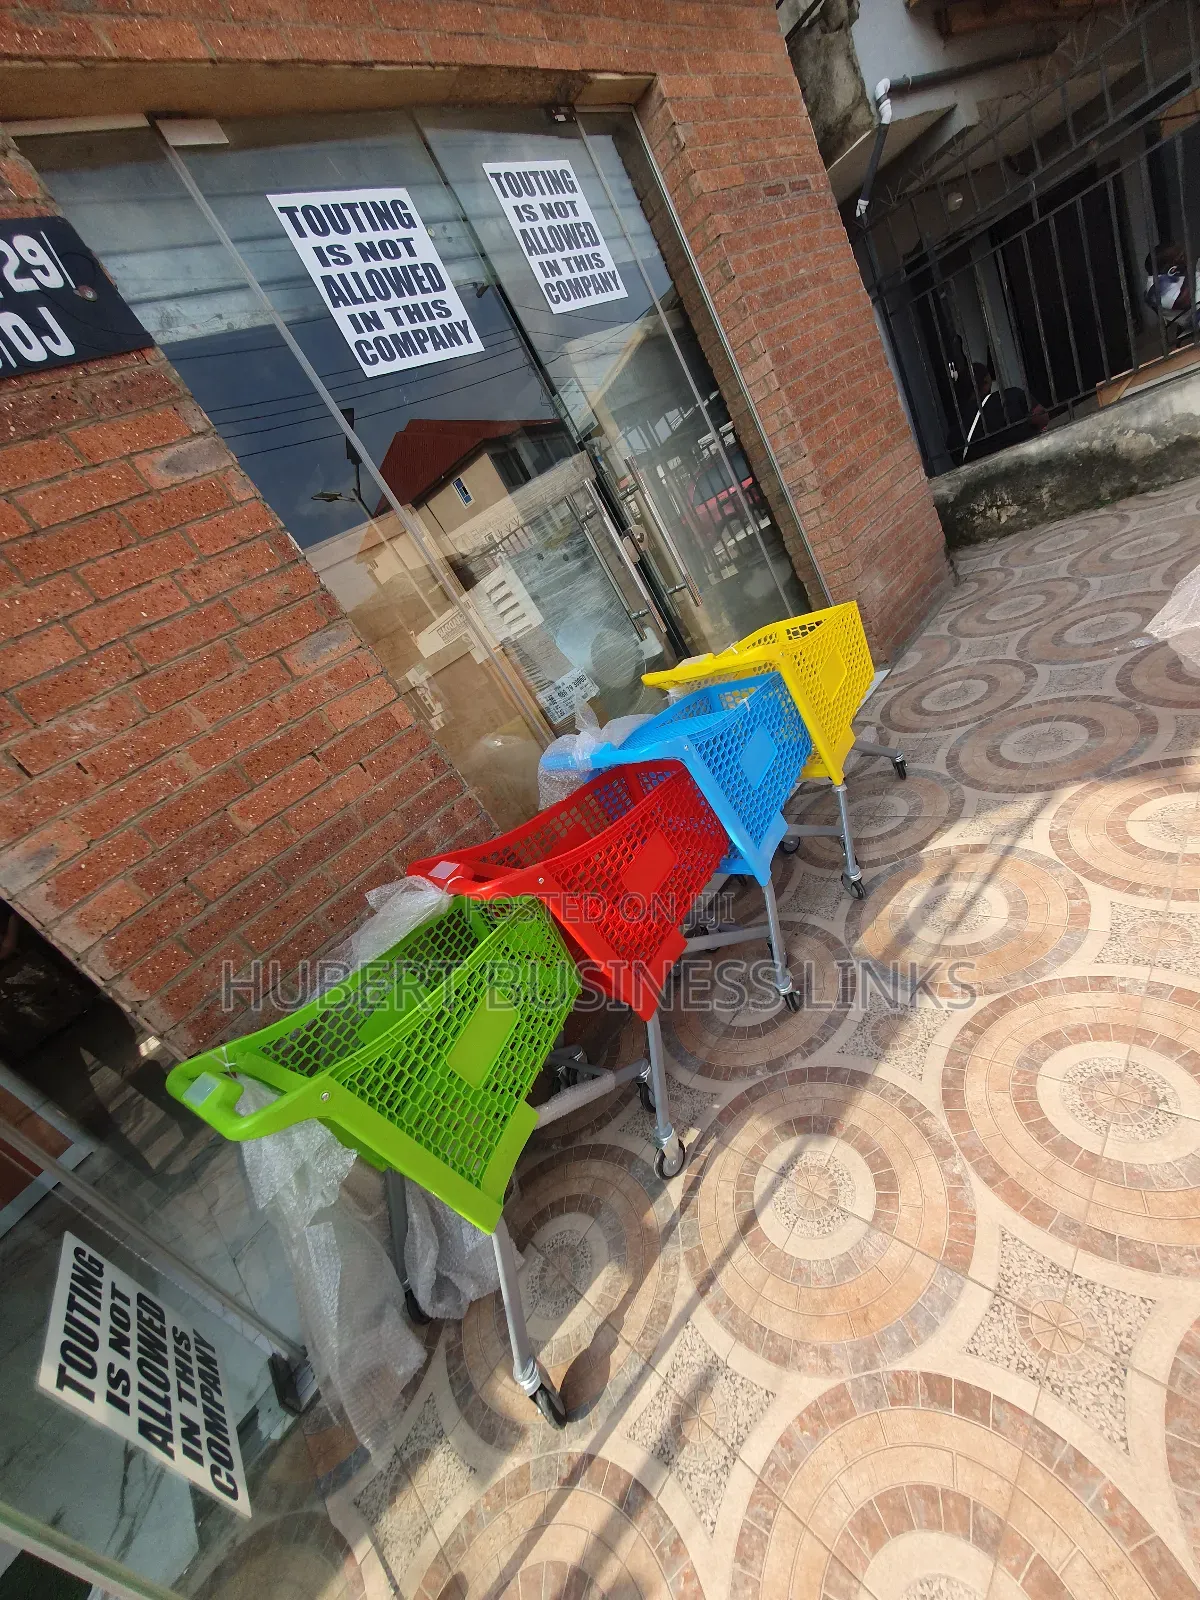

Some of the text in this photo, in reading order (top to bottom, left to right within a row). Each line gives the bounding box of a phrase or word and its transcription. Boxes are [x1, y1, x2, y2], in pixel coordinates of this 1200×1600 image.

[489, 168, 578, 199] TOUTING
[278, 199, 417, 239] TOUTING
[512, 200, 580, 223] IS NOT
[311, 237, 418, 268] IS NOT
[519, 221, 601, 257] ALLOWED
[320, 262, 447, 309] ALLOWED
[538, 252, 606, 279] IN THIS
[543, 270, 621, 305] COMPANY
[347, 299, 453, 335] IN THIS
[354, 319, 474, 366] COMPANY
[56, 1246, 104, 1403] TOUTING
[106, 1281, 131, 1416] IS NOT
[137, 1292, 175, 1461] ALLOWED
[172, 1326, 204, 1467] IN THIS
[193, 1328, 239, 1501] COMPANY
